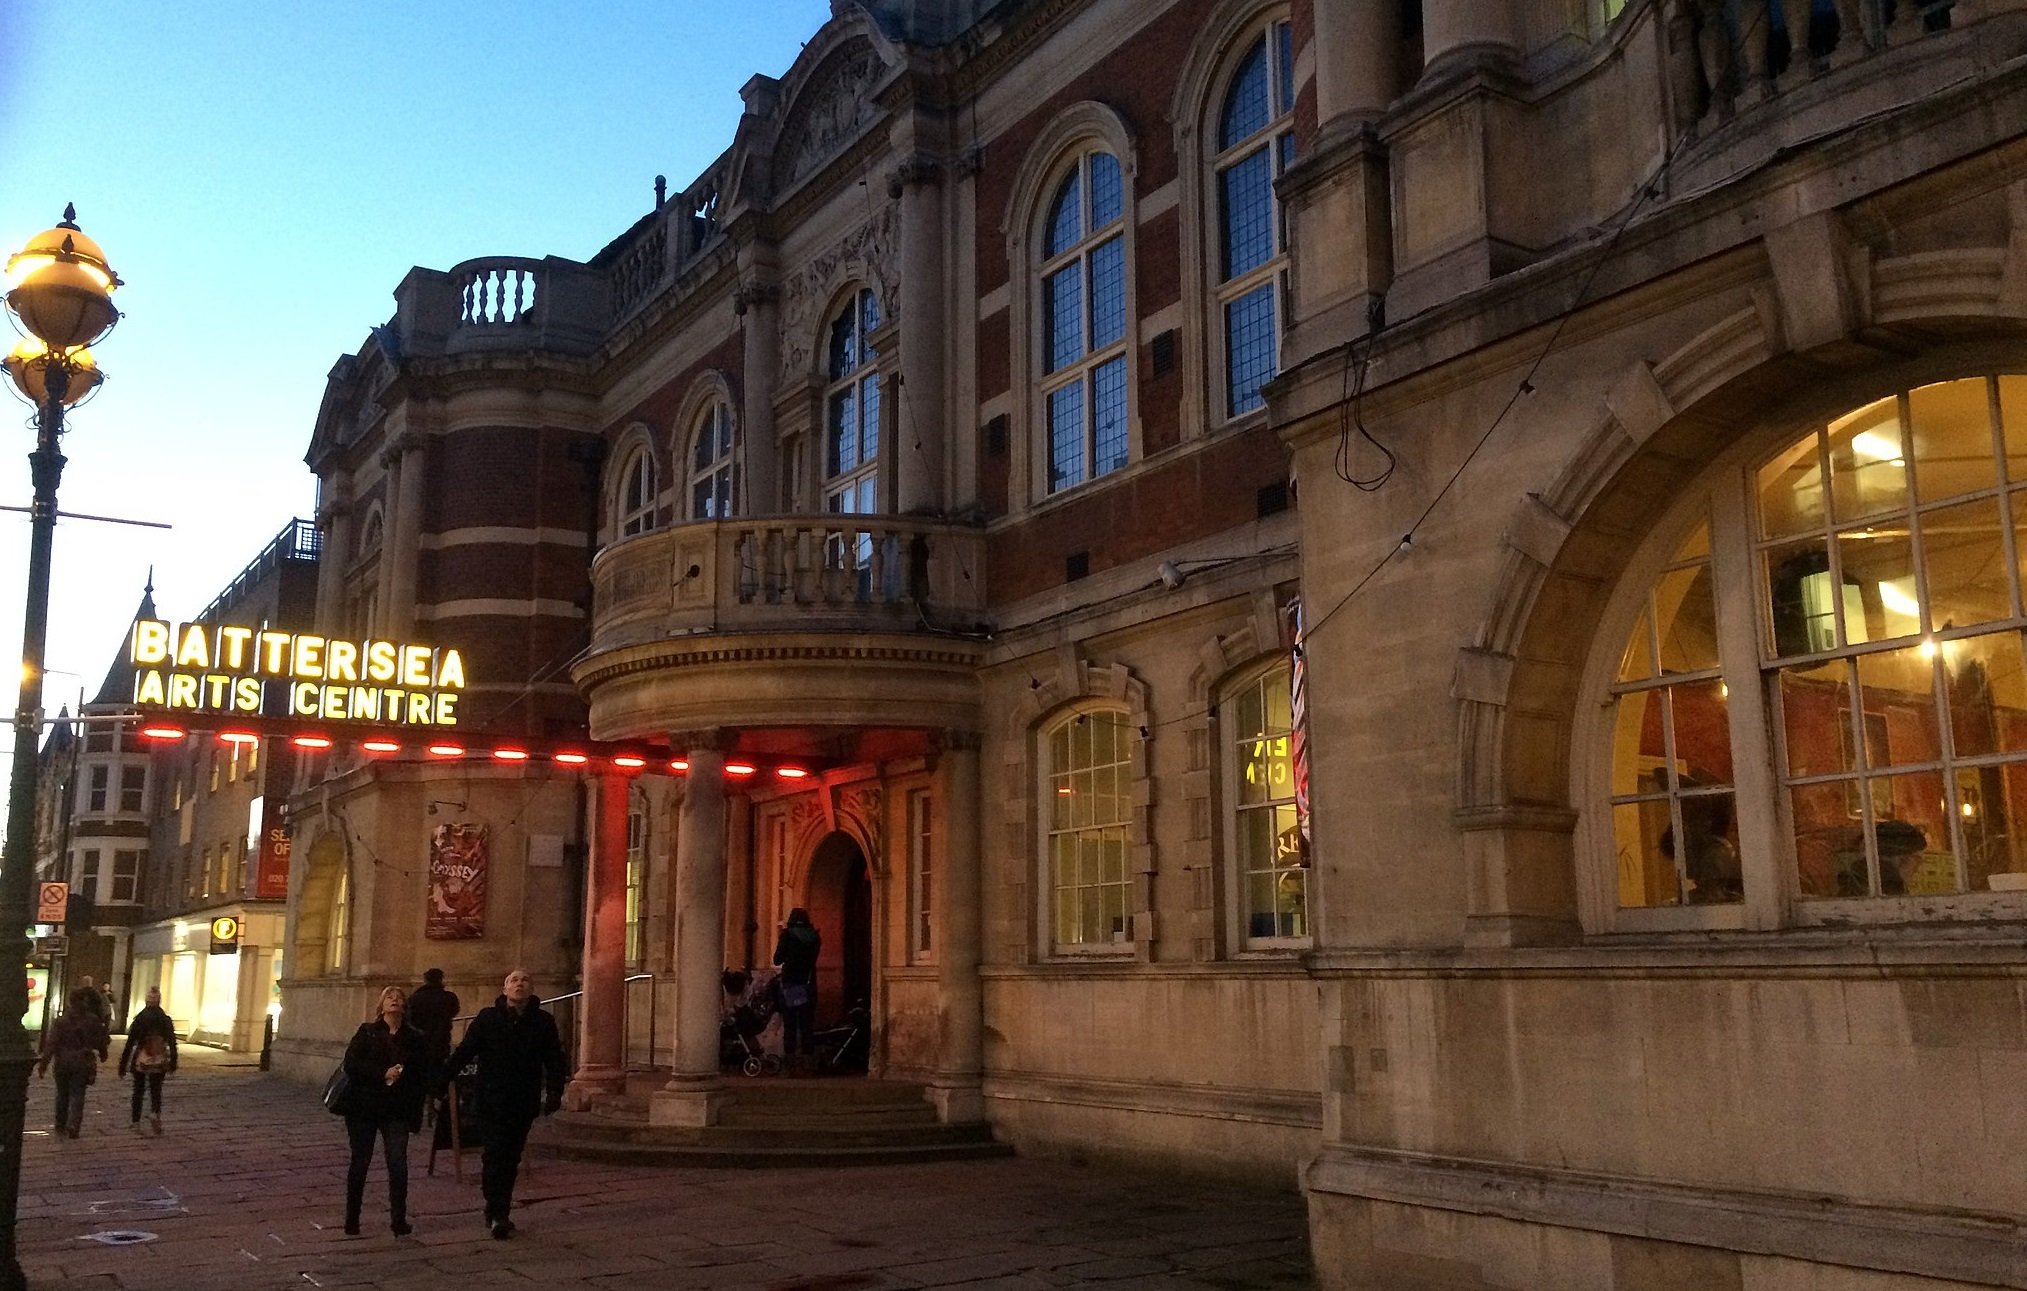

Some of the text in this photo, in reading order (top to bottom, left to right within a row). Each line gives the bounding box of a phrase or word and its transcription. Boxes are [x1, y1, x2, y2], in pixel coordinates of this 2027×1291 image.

[136, 620, 465, 688] BATTERSEA
[138, 670, 458, 725] ARTS CENTRE
